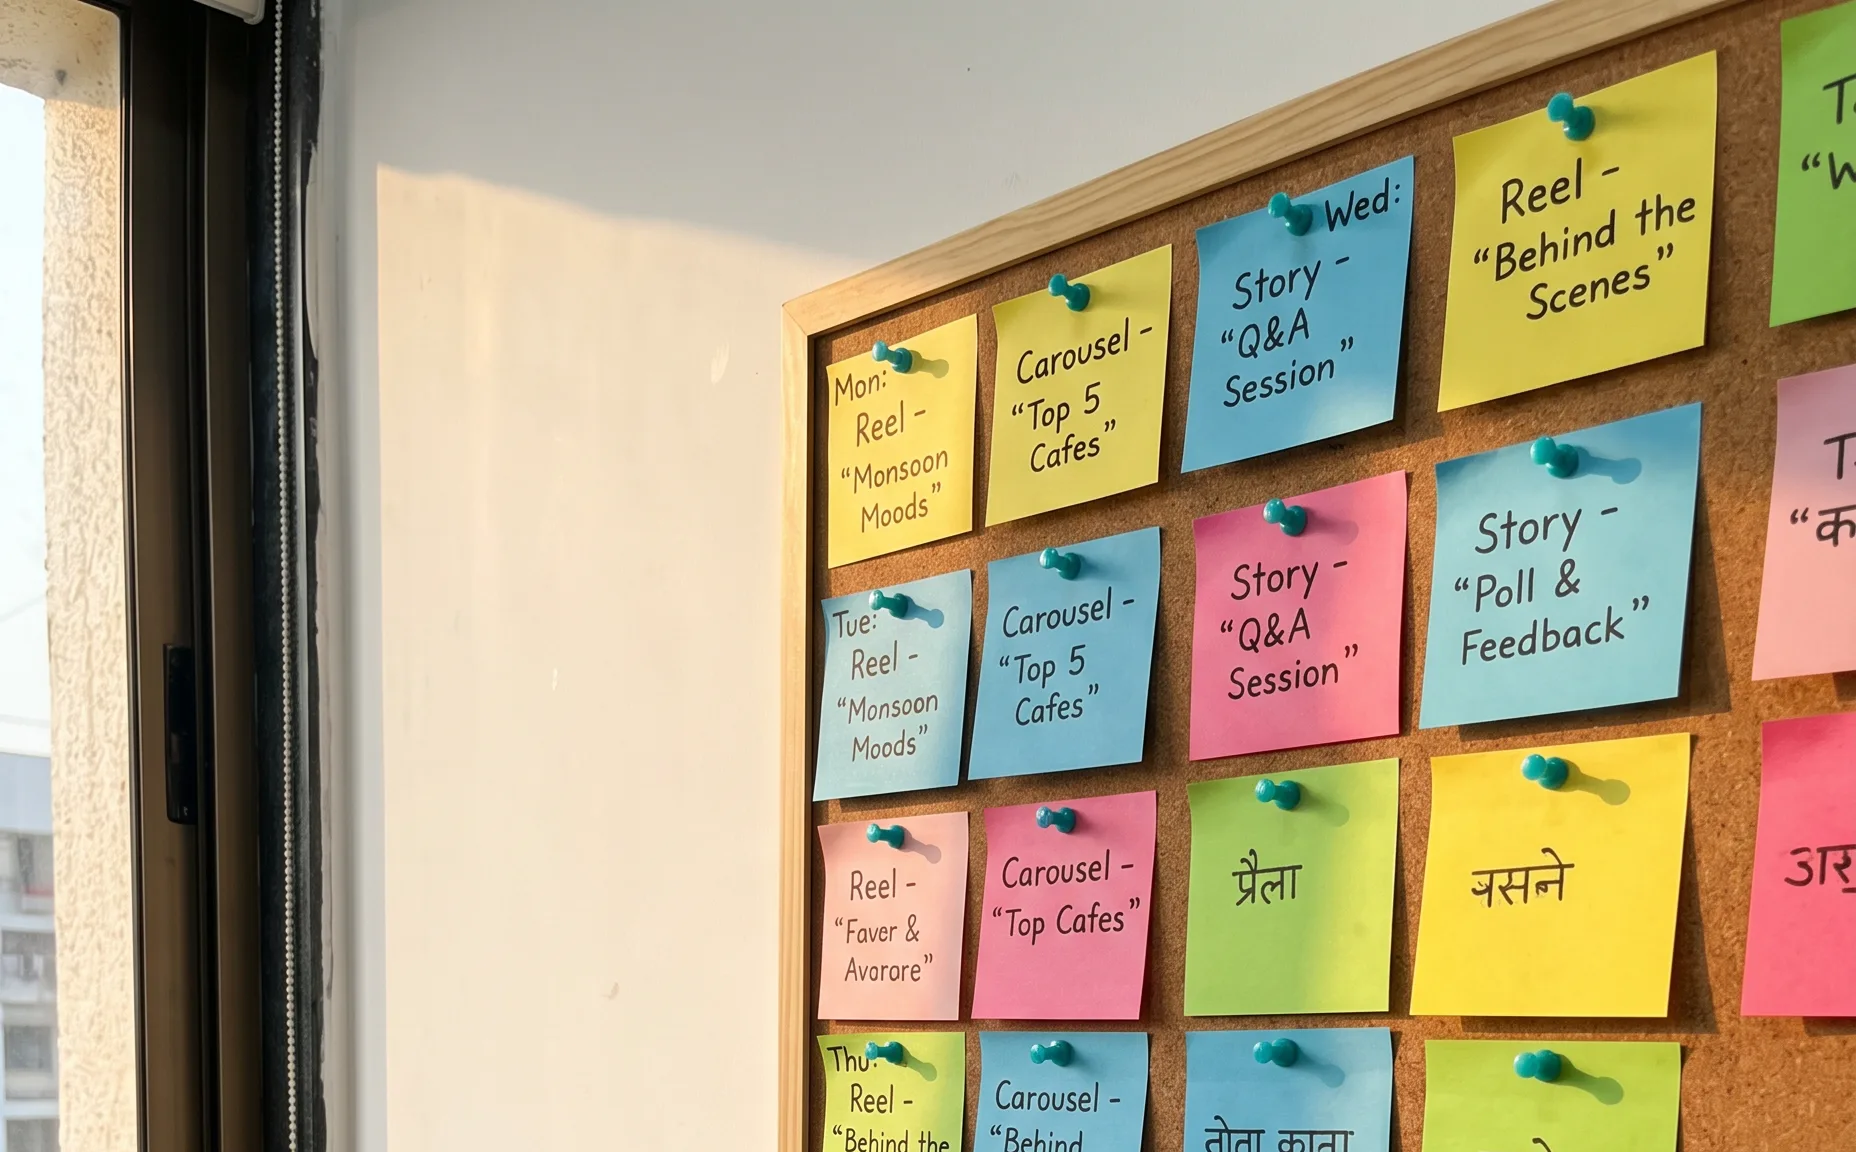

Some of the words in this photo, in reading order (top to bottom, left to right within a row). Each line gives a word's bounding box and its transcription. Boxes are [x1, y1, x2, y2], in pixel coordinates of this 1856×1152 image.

[1325, 177, 1400, 232] Wed:
[1502, 158, 1581, 224] Reel
[1474, 209, 1615, 281] “Behind
[1635, 194, 1695, 235] the
[1233, 260, 1321, 310] Story
[1526, 242, 1673, 320] Scenes”
[1017, 317, 1129, 384] Carousel
[1221, 307, 1309, 358] “Q&A
[835, 370, 886, 406] Mon:
[1224, 336, 1353, 407] Session”
[857, 400, 903, 447] Reel
[1012, 399, 1070, 434] “Top
[1084, 382, 1100, 414] 5
[1031, 419, 1115, 472] Cafes”
[842, 451, 947, 494] “Monsoon
[862, 482, 941, 533] Moods”
[1475, 509, 1582, 554] Story
[1231, 562, 1318, 600] Story
[1455, 567, 1534, 612] “Poll
[1555, 559, 1580, 597] &
[833, 610, 876, 638] Tue:
[1003, 587, 1111, 637] Carousel
[1221, 607, 1310, 653] “Q&A
[1462, 596, 1649, 665] Feedback”
[852, 640, 897, 680] Reel
[1000, 654, 1055, 689] “Top
[1069, 645, 1085, 675] 5
[1228, 644, 1358, 700] Session”
[838, 695, 938, 724] “Monsoon
[1016, 683, 1098, 726] Cafes”
[852, 724, 927, 761] Moods”
[851, 868, 896, 900] Reel
[1002, 849, 1110, 888] Carousel
[835, 917, 897, 943] “Faver
[906, 914, 919, 942] &
[993, 907, 1045, 945] “Top
[1057, 897, 1140, 934] Cafes”
[851, 1083, 893, 1114] Reel
[996, 1080, 1098, 1112] Carousel
